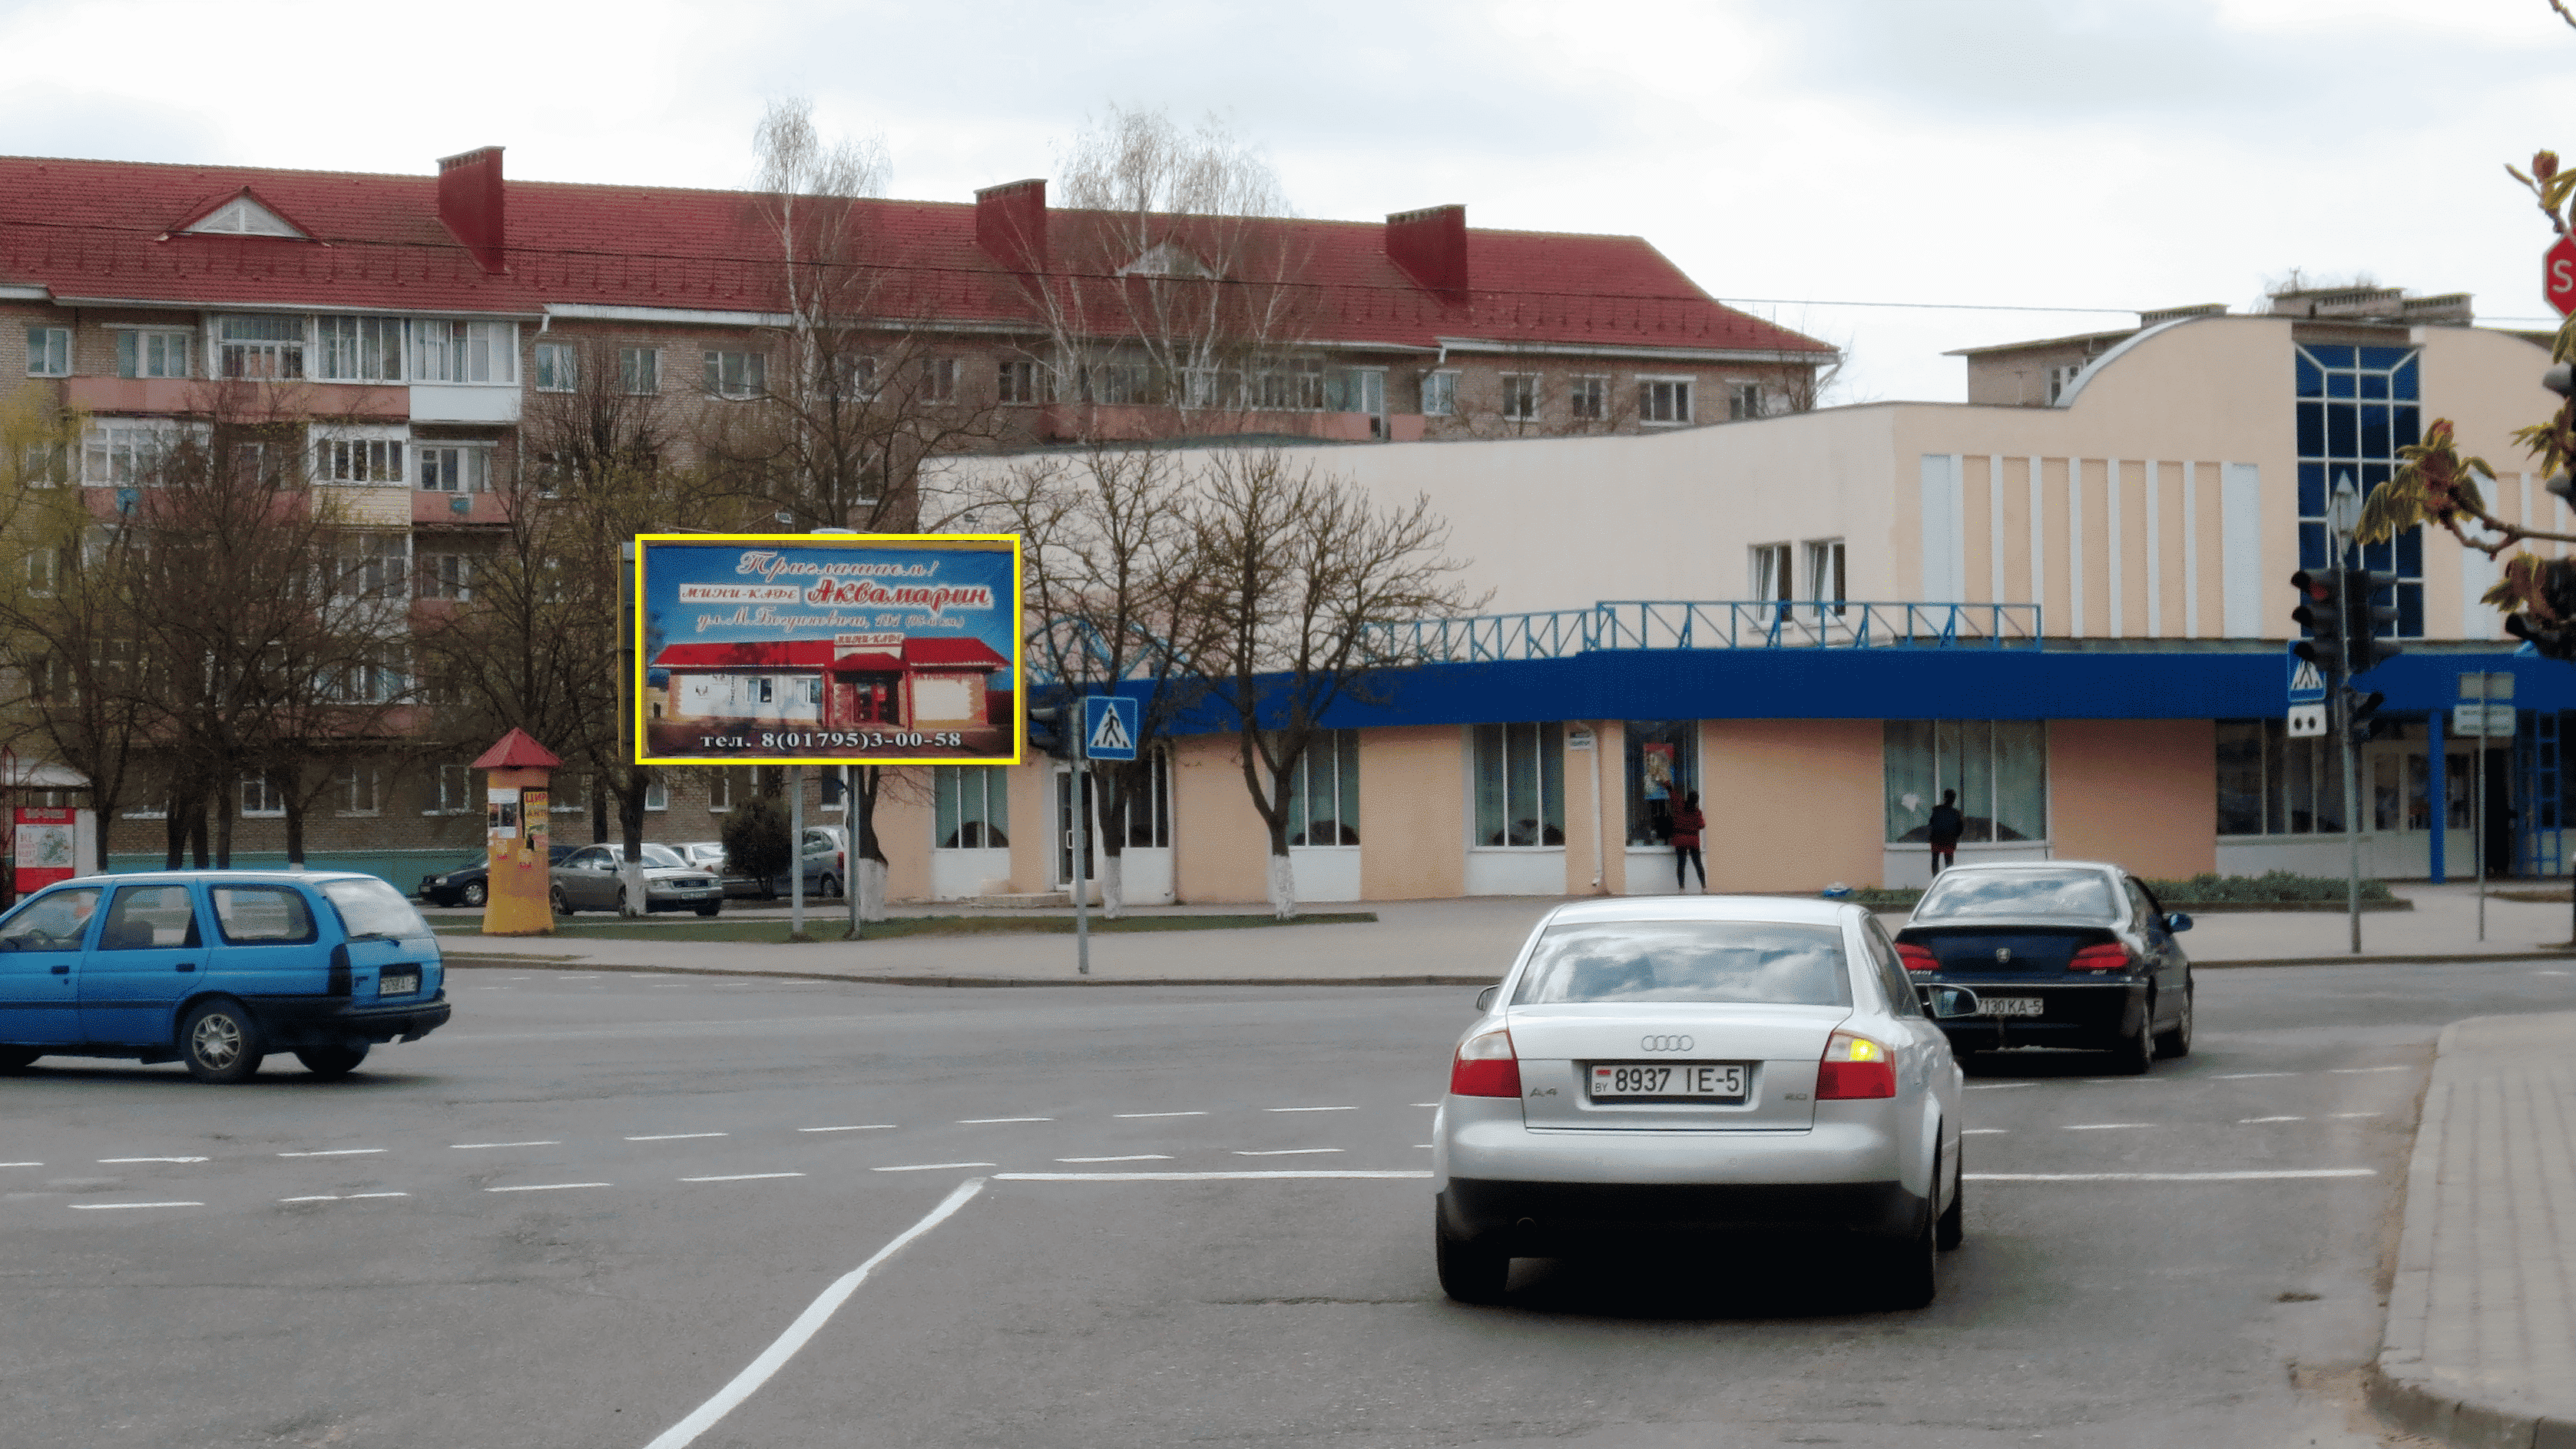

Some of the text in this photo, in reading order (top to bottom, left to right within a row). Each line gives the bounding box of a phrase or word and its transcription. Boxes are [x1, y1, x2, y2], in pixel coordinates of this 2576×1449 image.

[735, 551, 939, 582] Приглашаем!
[682, 579, 992, 612] МИНИ-КАФЕ Аквамарин
[700, 732, 961, 748] тел. 8(01795)3-00-58
[2008, 999, 2043, 1014] KA-5
[1595, 1068, 1740, 1092] BY 8937 IE-5
